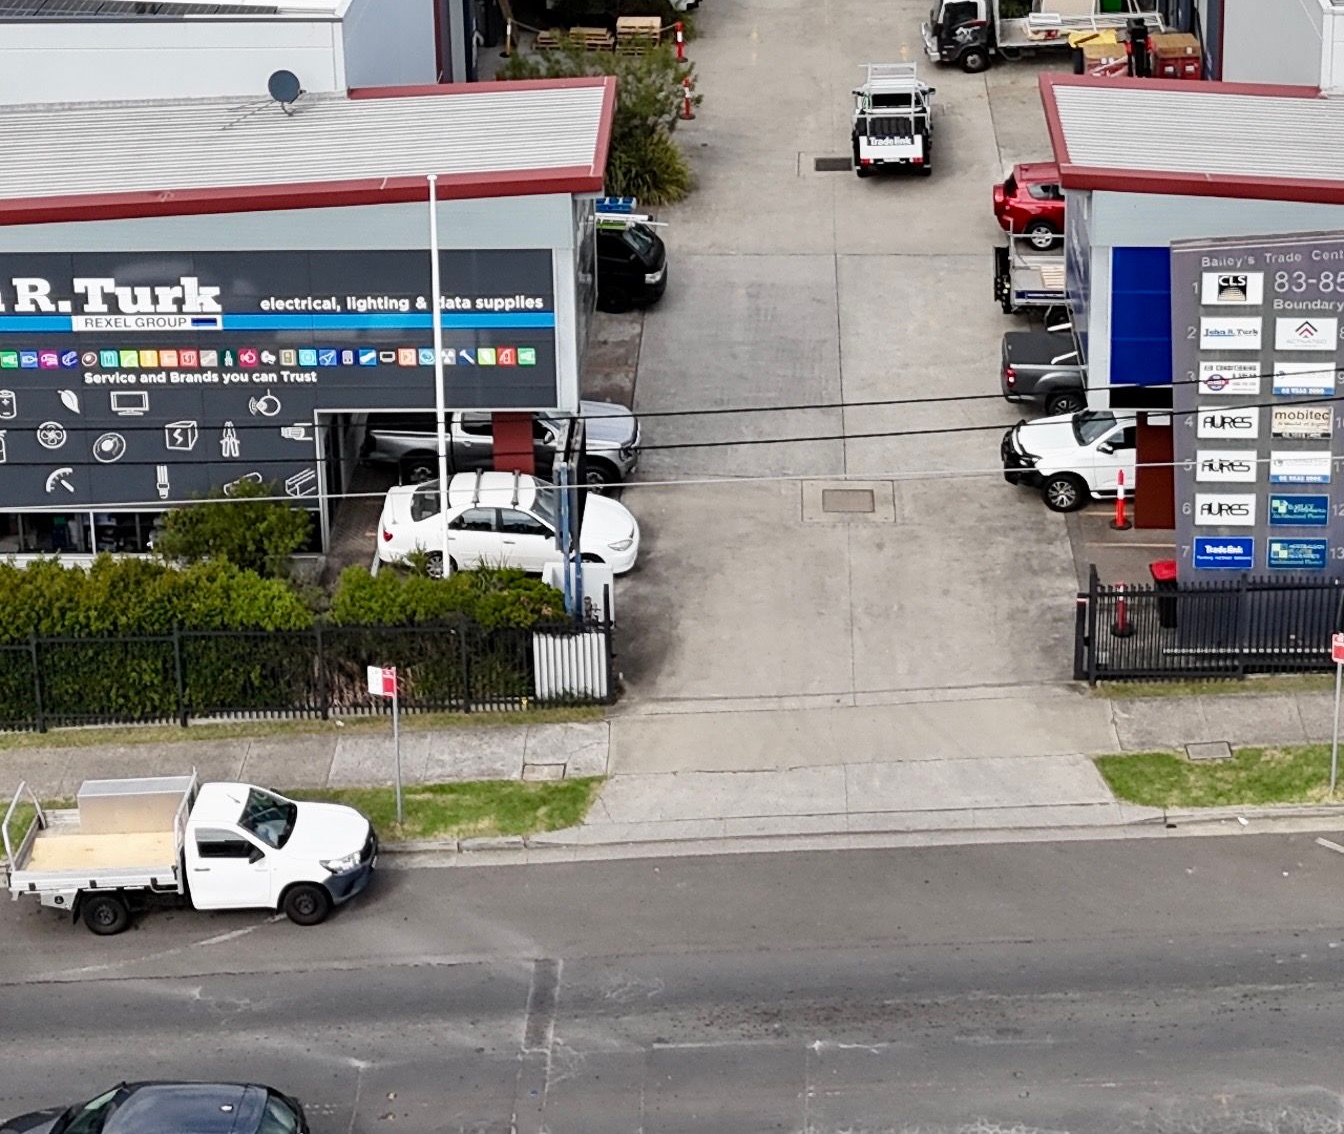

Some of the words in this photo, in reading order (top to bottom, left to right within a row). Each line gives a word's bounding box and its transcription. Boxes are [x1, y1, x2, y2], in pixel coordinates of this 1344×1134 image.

[869, 136, 912, 146] Tradelink
[1201, 255, 1255, 268] Bailey's
[1264, 252, 1302, 264] Trade
[1218, 275, 1246, 287] CLS
[1192, 281, 1199, 294] 1
[12, 277, 72, 313] R.
[73, 277, 222, 313] Turk
[260, 296, 341, 312] electrical,
[346, 296, 410, 312] lighting
[415, 296, 427, 309] &
[436, 296, 471, 310] data
[475, 296, 544, 311] supplies
[1273, 299, 1344, 312] Boundary
[84, 317, 133, 328] REXEL
[135, 317, 187, 328] GROUP
[1187, 327, 1196, 338] 2
[1237, 328, 1258, 336] Turk
[84, 371, 137, 384] Service
[139, 371, 169, 384] and
[170, 371, 219, 384] Brands
[222, 372, 250, 385] you
[252, 371, 278, 383] can
[280, 370, 317, 382] Trust
[1274, 409, 1330, 421] mobitec
[1184, 416, 1193, 427] 4
[1203, 415, 1252, 429] AURES
[1201, 459, 1250, 473] AURES
[1182, 503, 1191, 515] 6
[1201, 503, 1250, 517] AURES
[1181, 546, 1190, 557] 7
